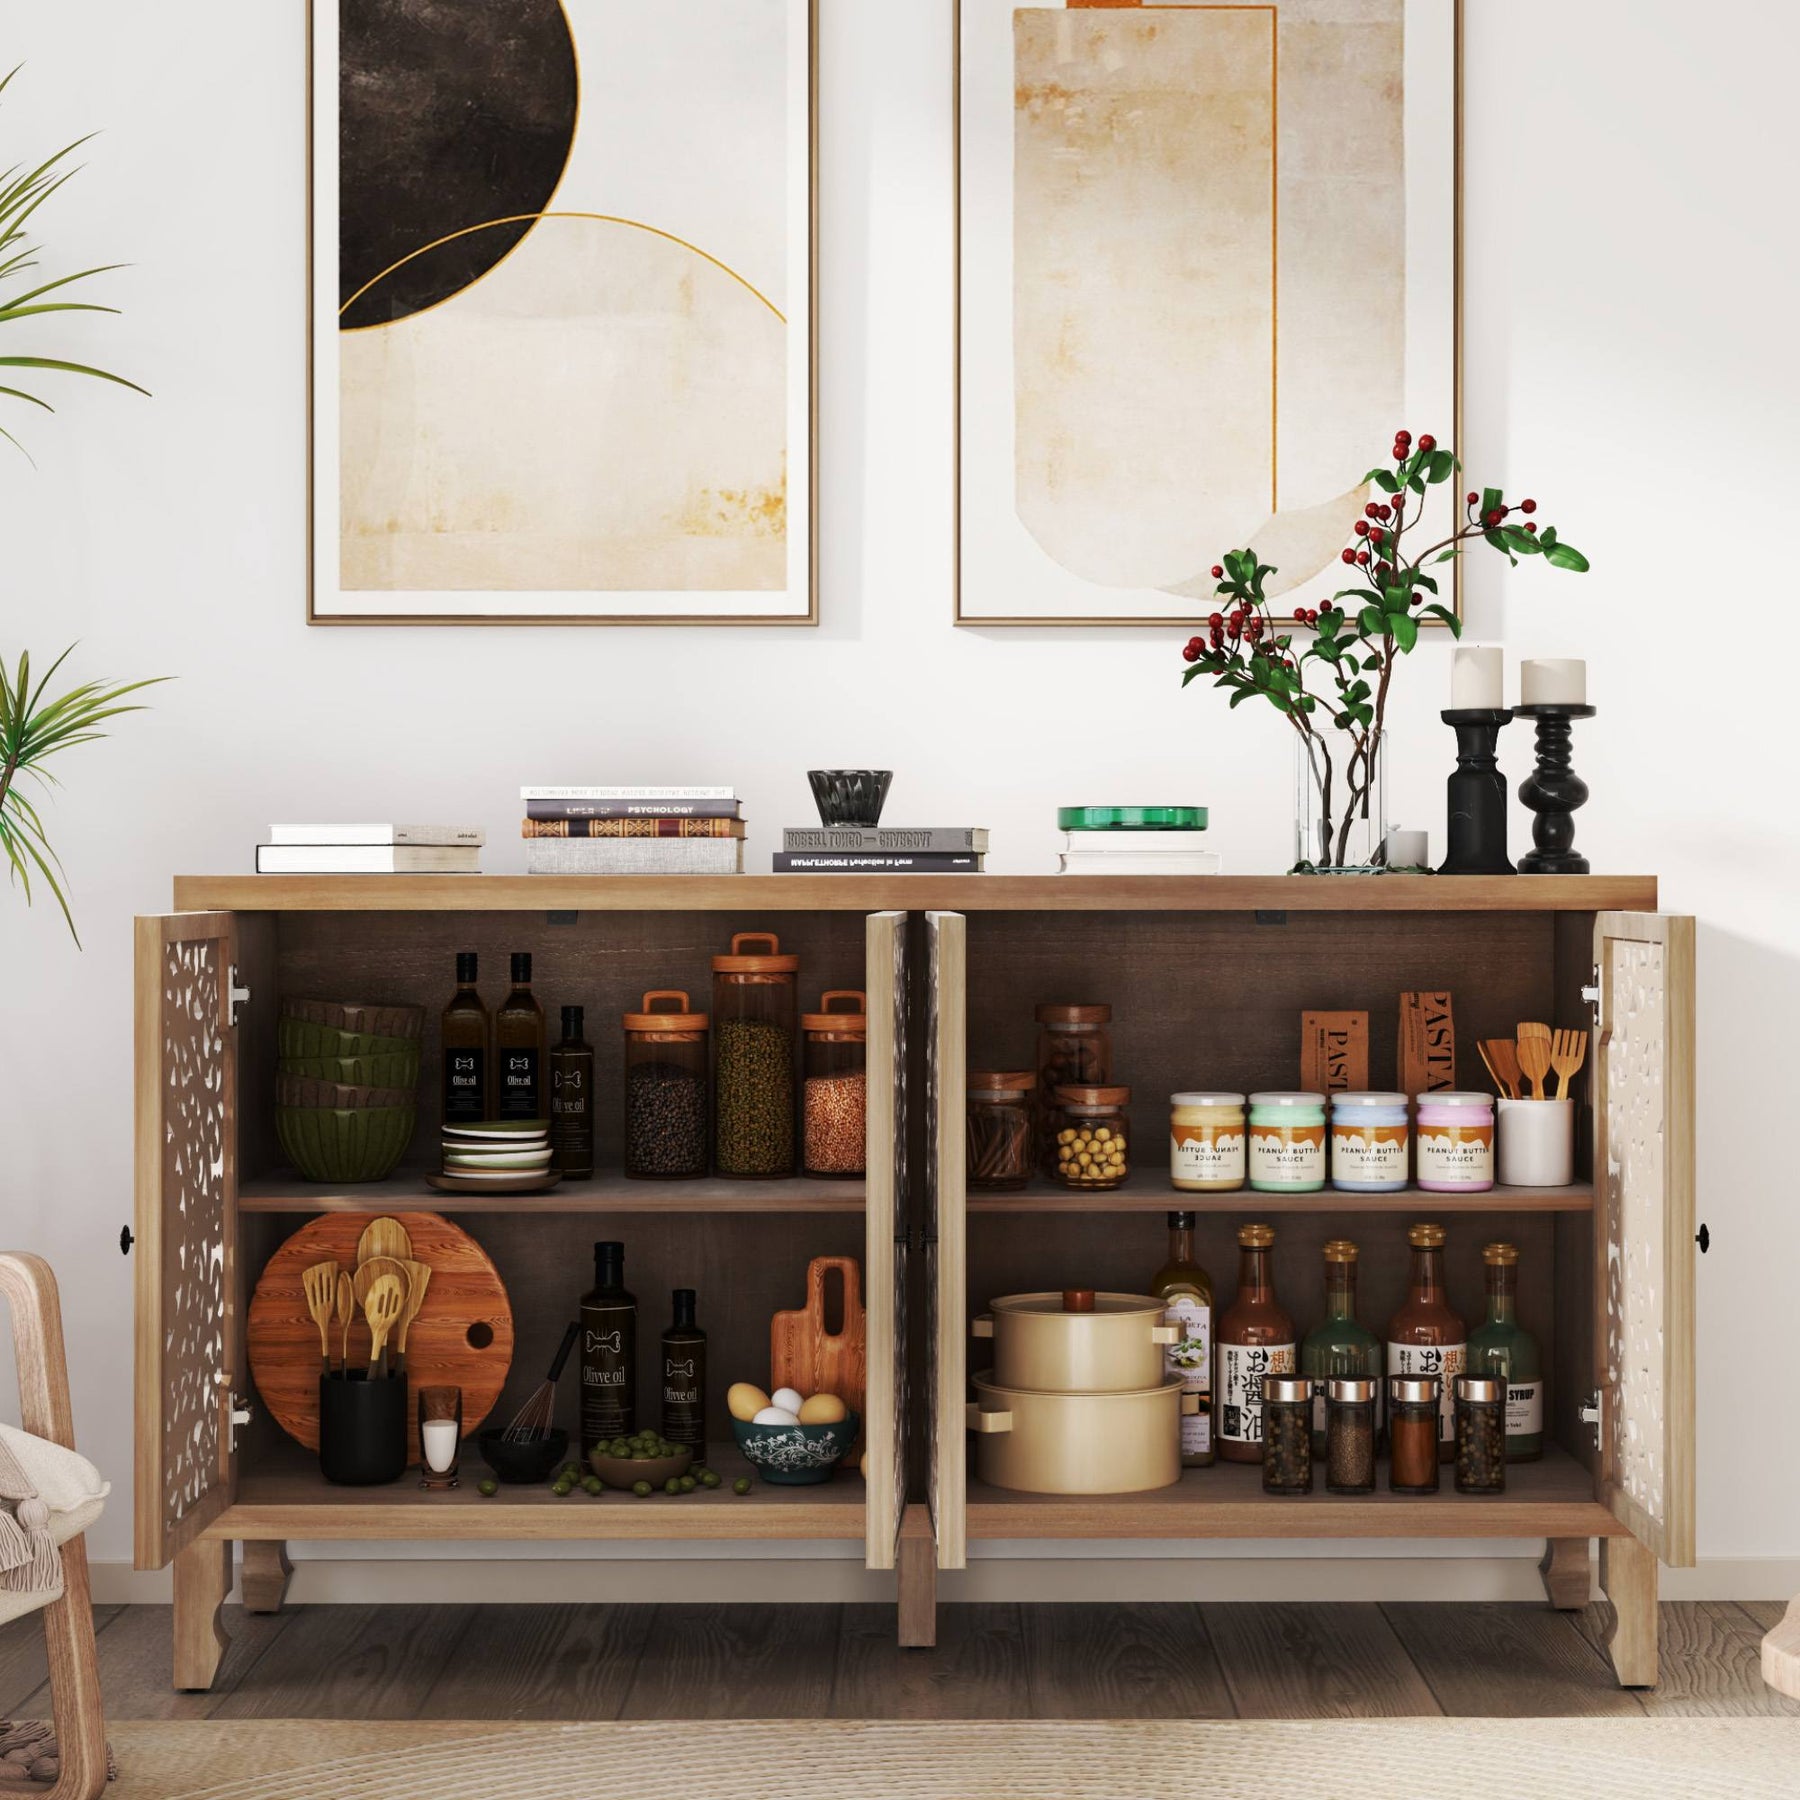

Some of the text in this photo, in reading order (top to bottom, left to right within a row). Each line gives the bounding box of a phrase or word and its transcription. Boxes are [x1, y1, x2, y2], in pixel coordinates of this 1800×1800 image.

[628, 806, 694, 814] PSYCHOLOGY
[1328, 1029, 1348, 1092] PAST
[612, 1366, 625, 1383] oil
[1508, 1388, 1535, 1401] SYRUP
